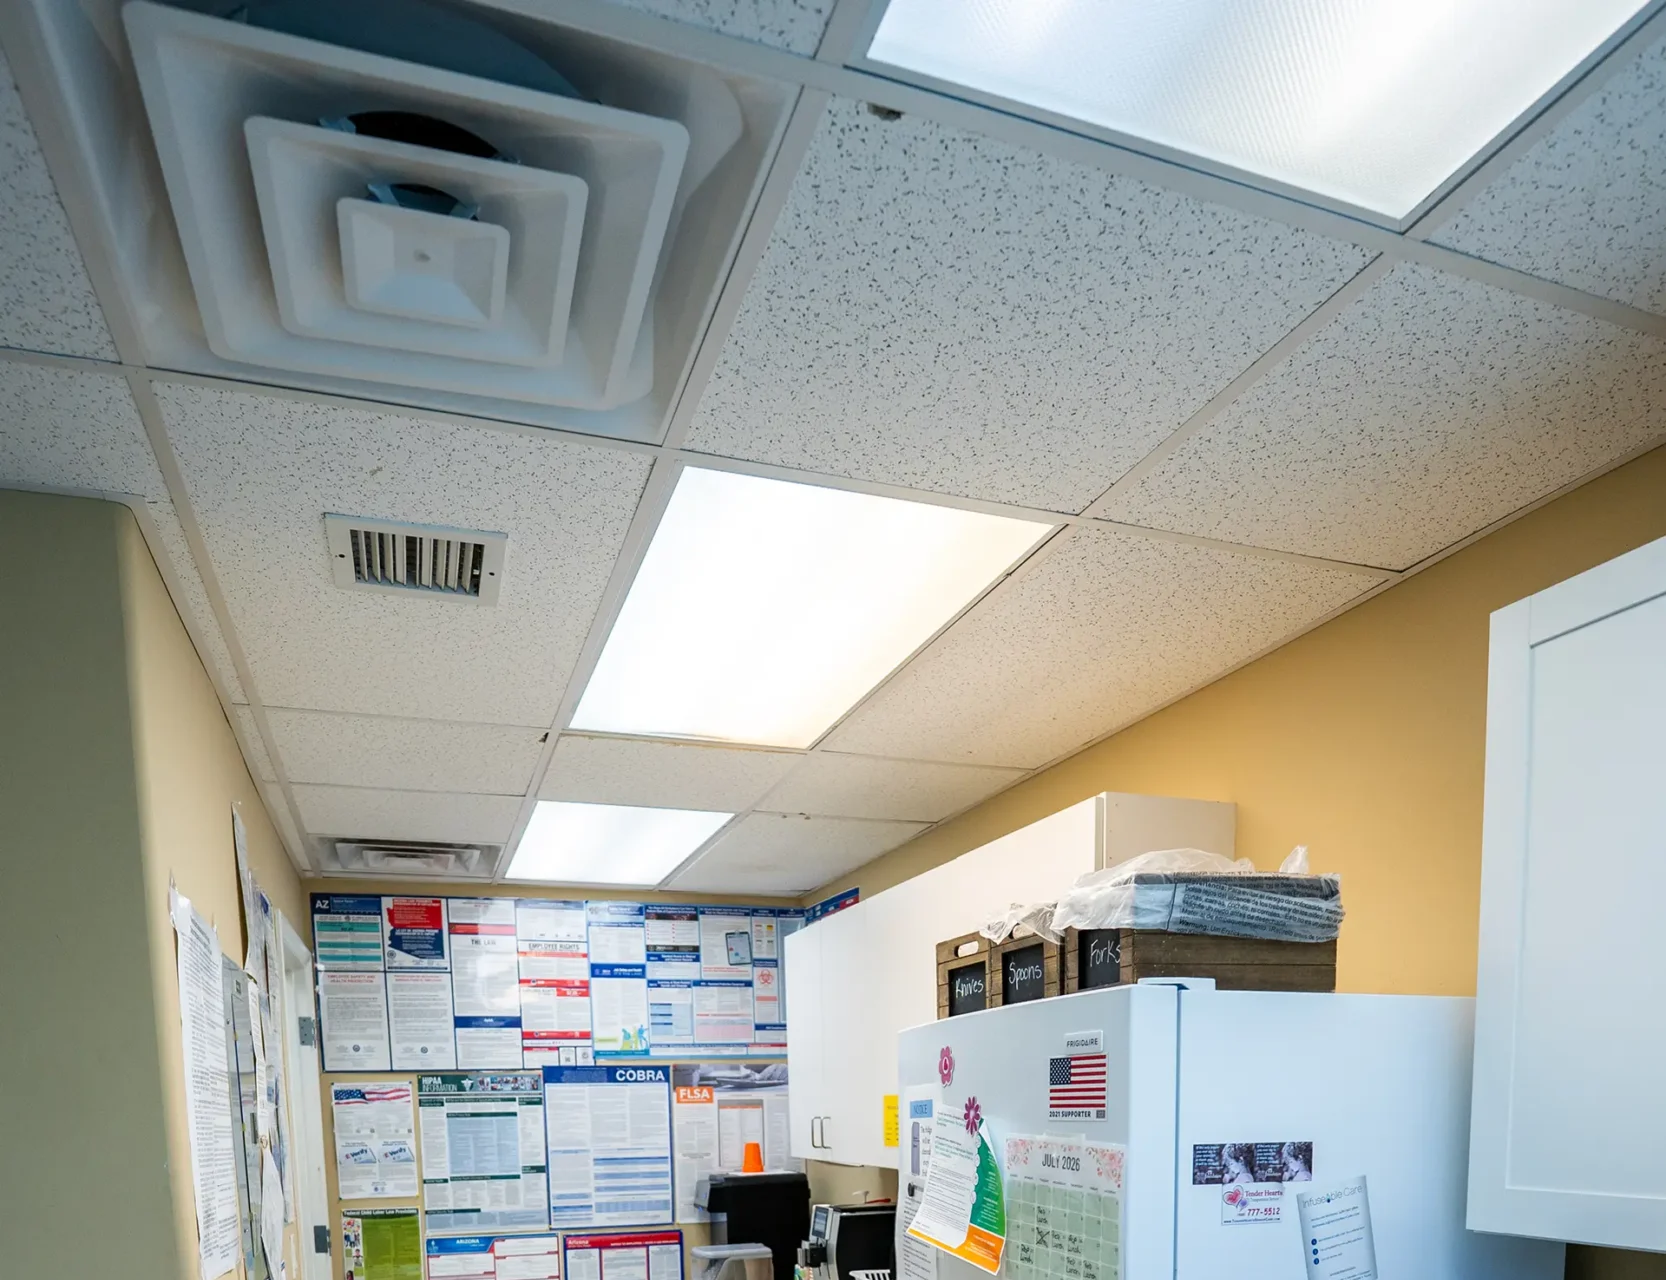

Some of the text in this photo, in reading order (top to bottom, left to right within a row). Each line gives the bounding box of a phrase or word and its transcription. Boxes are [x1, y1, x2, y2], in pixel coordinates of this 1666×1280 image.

[315, 900, 330, 909] AZ
[1008, 961, 1043, 991] Spoons
[955, 978, 984, 999] Knives
[1066, 1037, 1099, 1048] FRIGIDAIRE
[615, 1070, 665, 1082] COBRA
[679, 1088, 711, 1099] FLSA
[1061, 1110, 1092, 1118] SUPPORTER
[1041, 1153, 1081, 1172] JULY 2026
[1264, 1189, 1283, 1197] Hearts
[1343, 1185, 1363, 1197] Care
[1247, 1207, 1281, 1217] 777-5512
